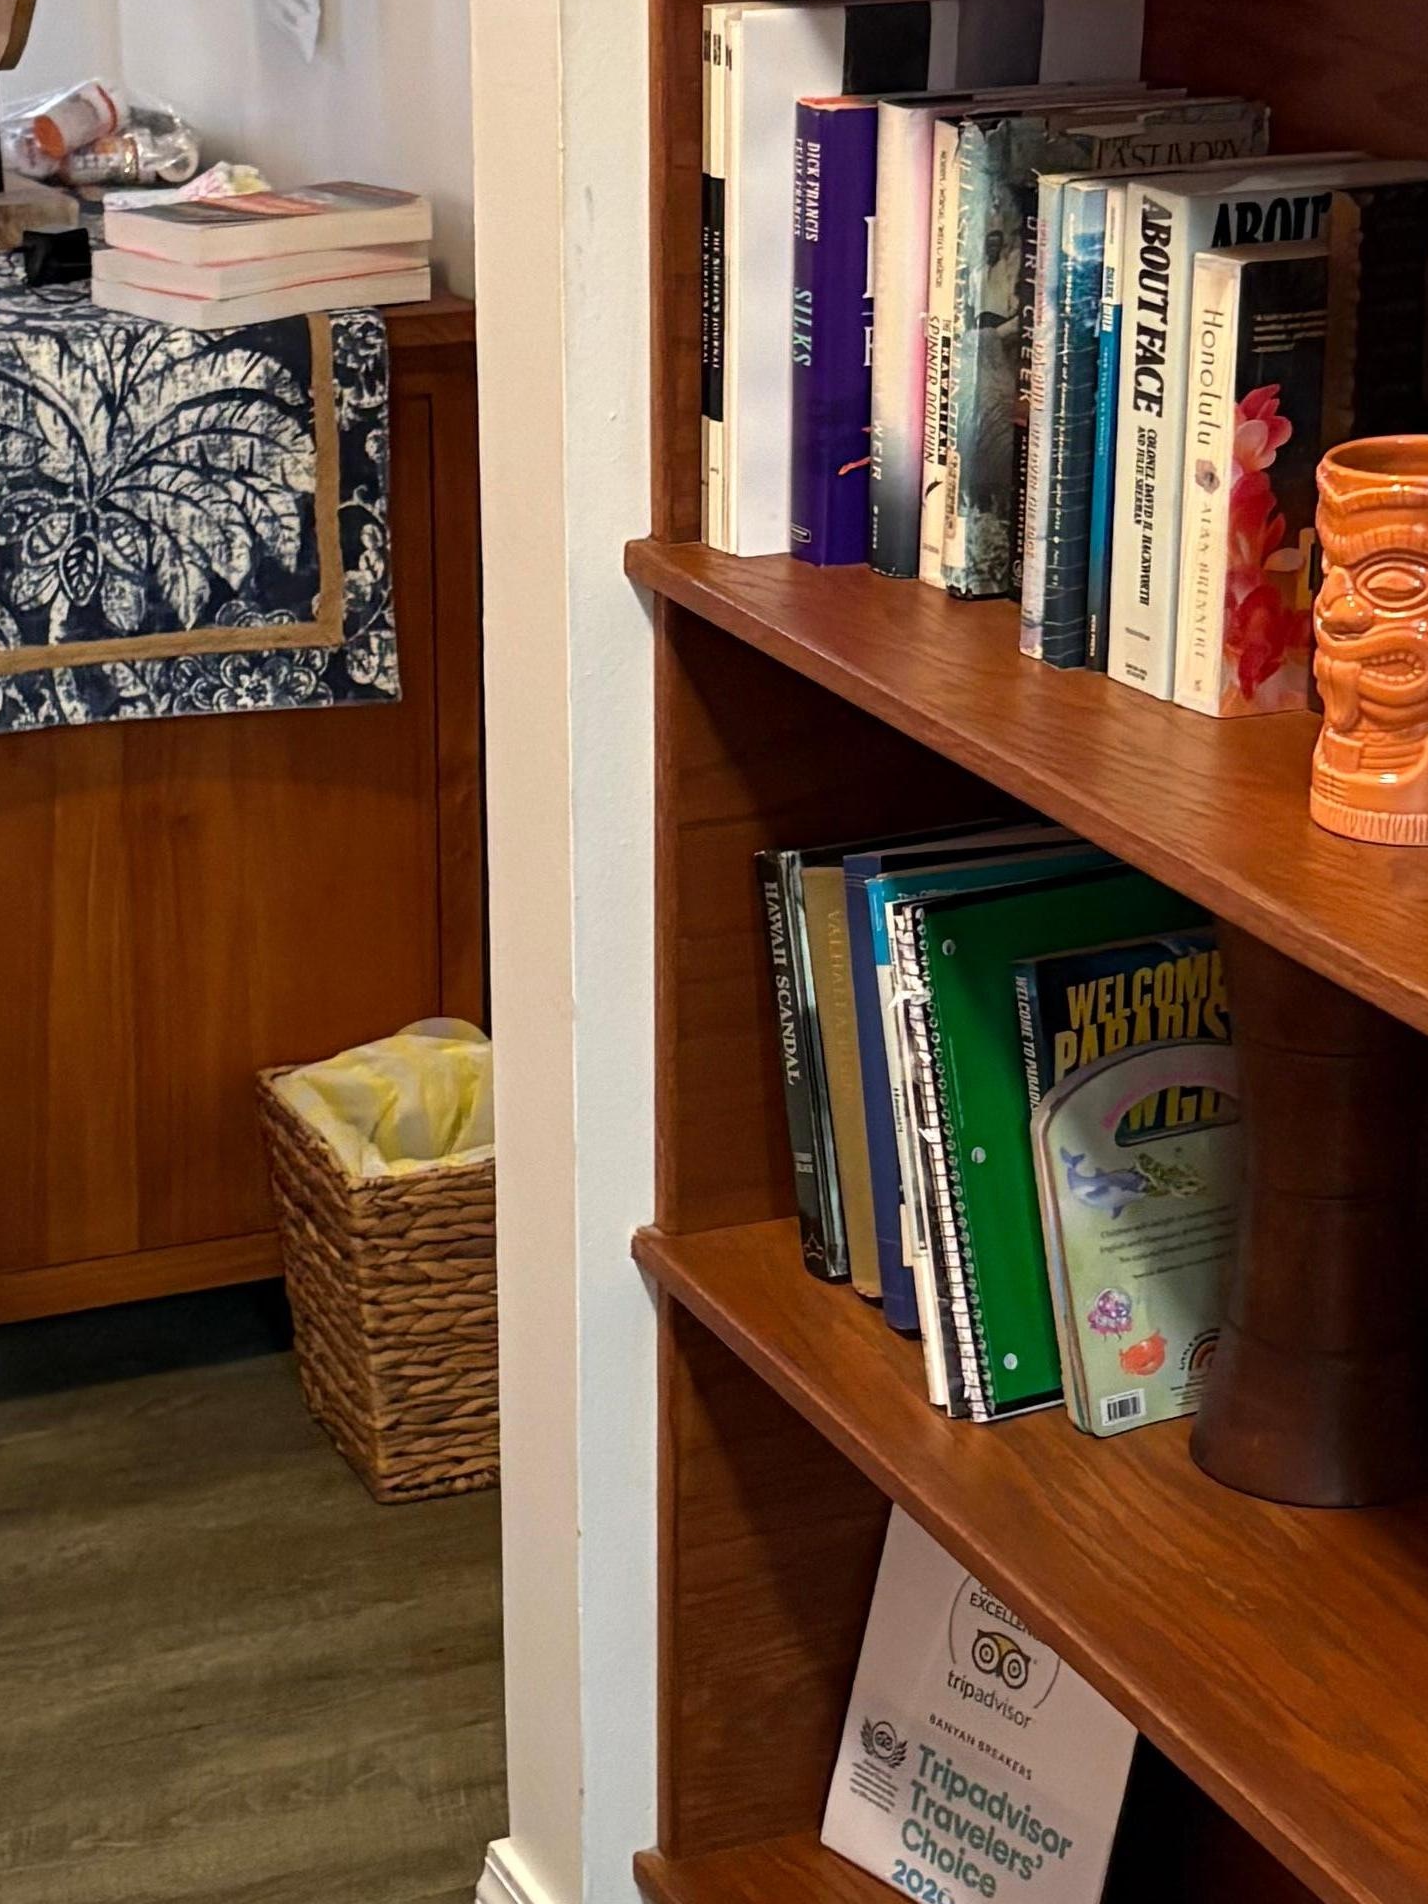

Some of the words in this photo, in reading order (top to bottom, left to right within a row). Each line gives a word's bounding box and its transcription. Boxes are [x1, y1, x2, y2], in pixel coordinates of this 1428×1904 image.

[806, 140, 823, 178] DICK
[803, 178, 822, 244] FRANCIS
[1024, 215, 1039, 286] DIRT
[1138, 194, 1173, 326] ABOUT
[792, 285, 813, 369] SILKS
[925, 314, 941, 390] SPINNER
[1019, 305, 1036, 403] CREEK
[1132, 320, 1167, 419] FACE
[1194, 306, 1225, 447] Honolulu
[872, 418, 883, 482] WEIR
[923, 391, 939, 465] DOLPHIN
[762, 880, 791, 972] HAWAII
[774, 972, 803, 1088] SCANDAL
[1015, 975, 1035, 1038] WELCOME
[947, 1669, 1032, 1730] tripadvisor
[928, 1712, 976, 1747] BANYAN
[977, 1740, 1033, 1781] BREAKERS
[909, 1779, 1045, 1882] Travelers'
[918, 1741, 1074, 1860] Tripadvisor
[901, 1817, 998, 1900] Choice
